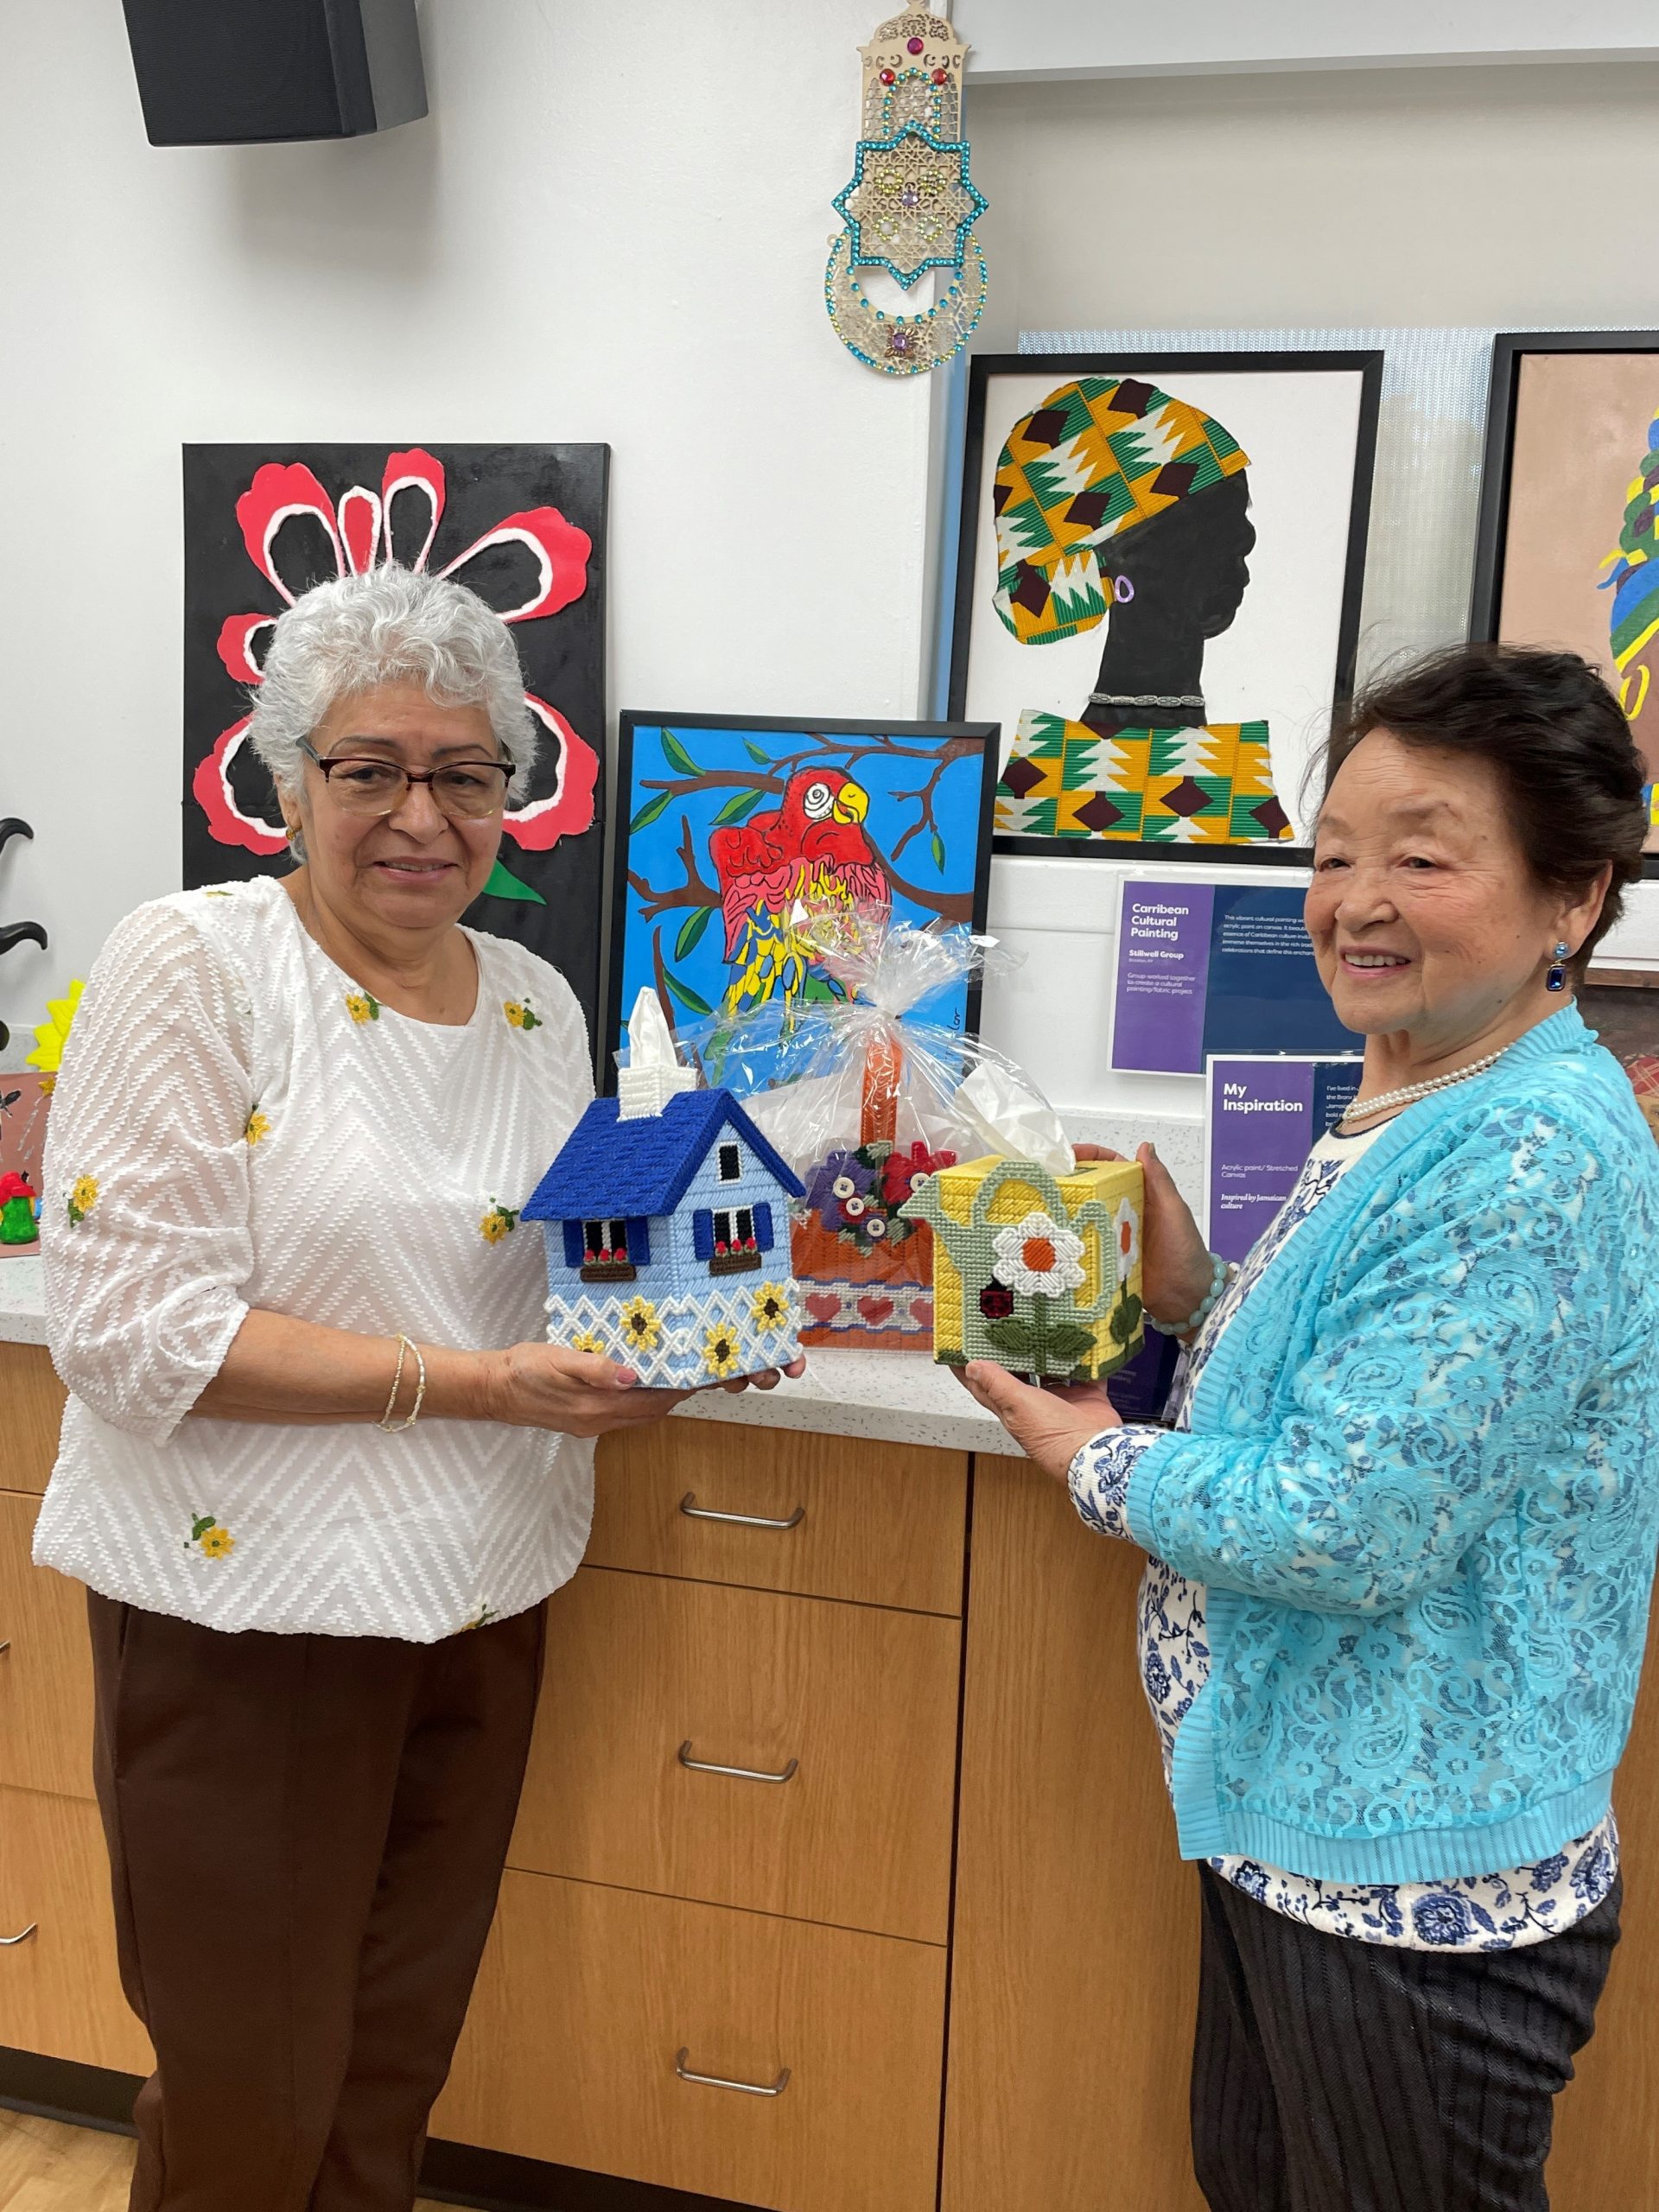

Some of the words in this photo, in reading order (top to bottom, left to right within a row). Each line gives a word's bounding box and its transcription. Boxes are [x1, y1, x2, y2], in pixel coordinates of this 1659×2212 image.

[1132, 903, 1189, 915] Carribean
[1131, 915, 1177, 926] Cultural
[1130, 927, 1179, 941] Painting
[1128, 949, 1159, 957] Stillwell
[1160, 950, 1184, 960] Group
[1224, 1083, 1247, 1098] My
[1224, 1098, 1303, 1114] Inspiration
[1221, 1193, 1248, 1203] Inspired
[1248, 1194, 1256, 1203] by
